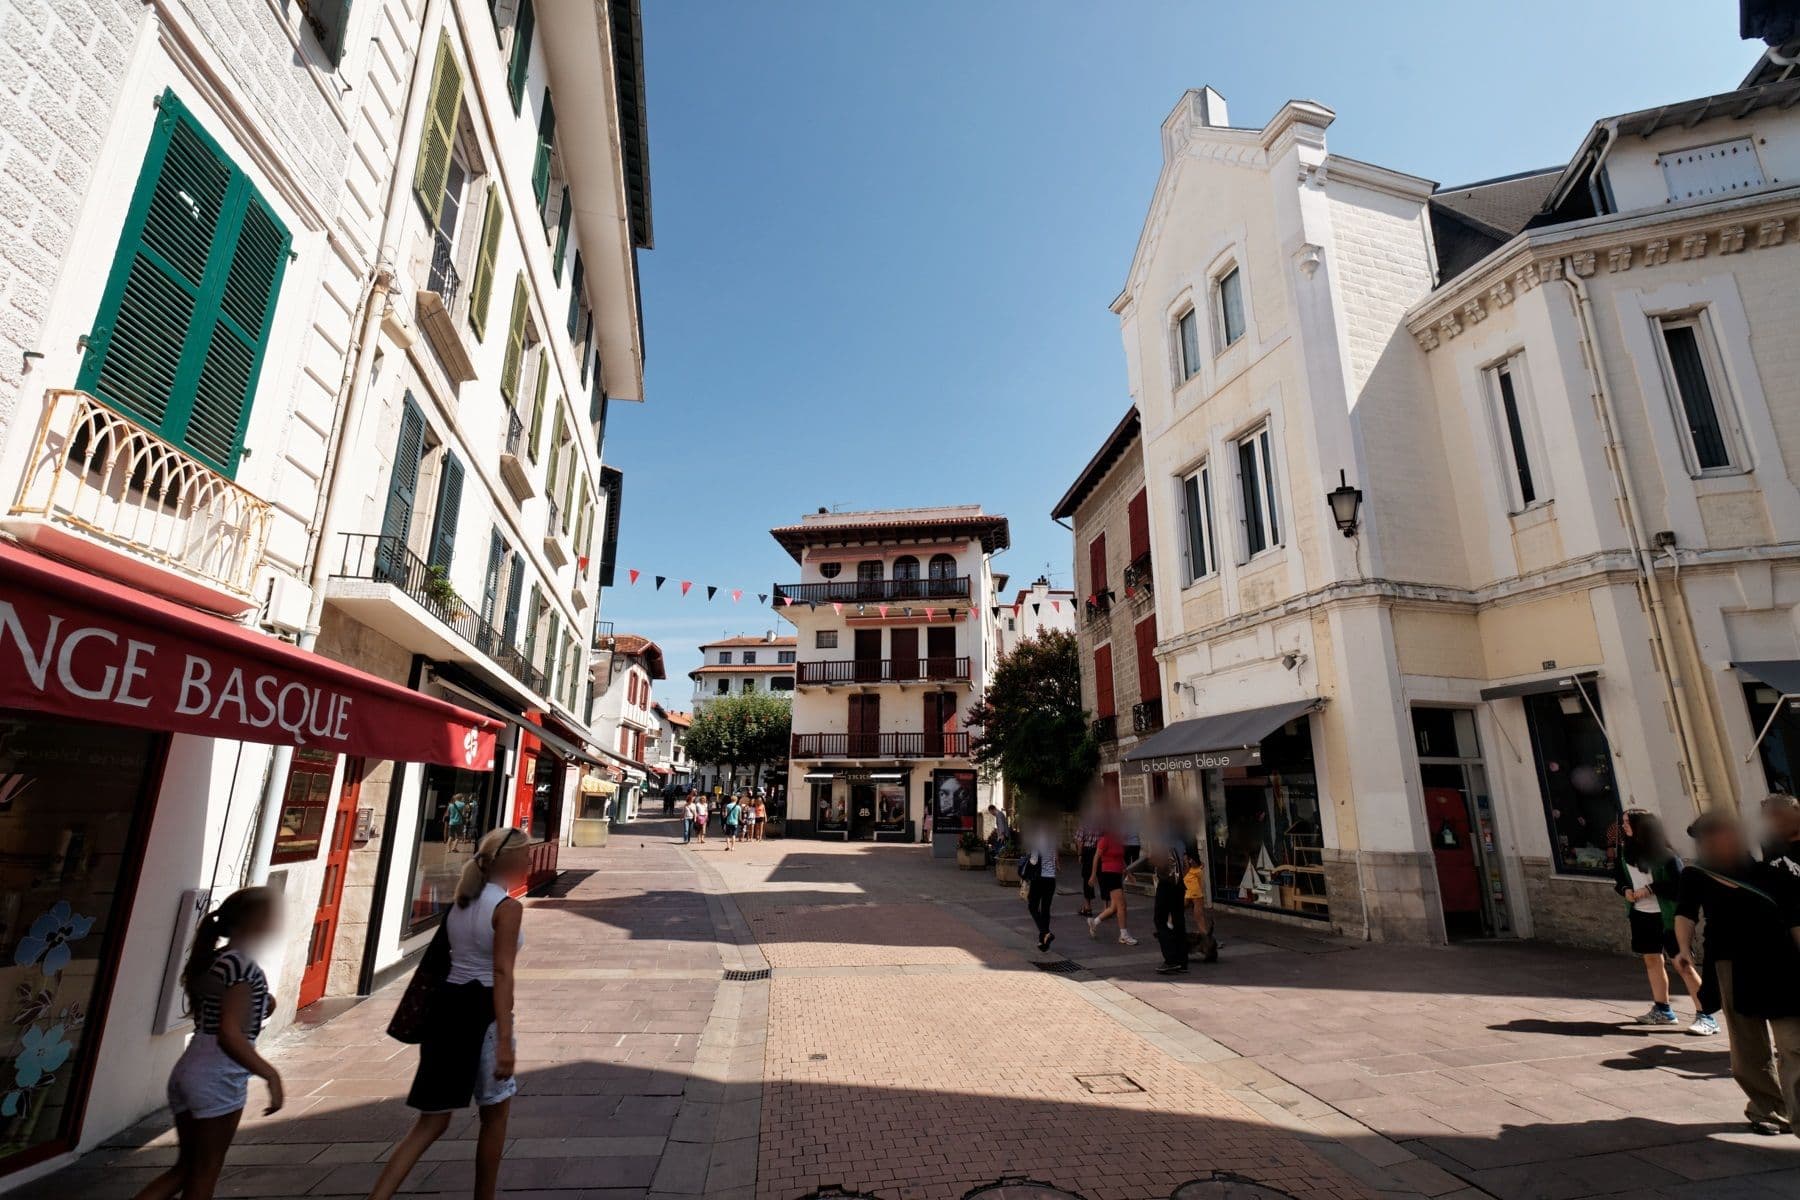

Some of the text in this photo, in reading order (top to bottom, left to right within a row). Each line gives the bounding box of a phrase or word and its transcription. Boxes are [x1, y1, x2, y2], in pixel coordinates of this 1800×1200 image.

[0, 602, 353, 743] NGE BASQUE
[1141, 753, 1230, 772] la baleine bleue
